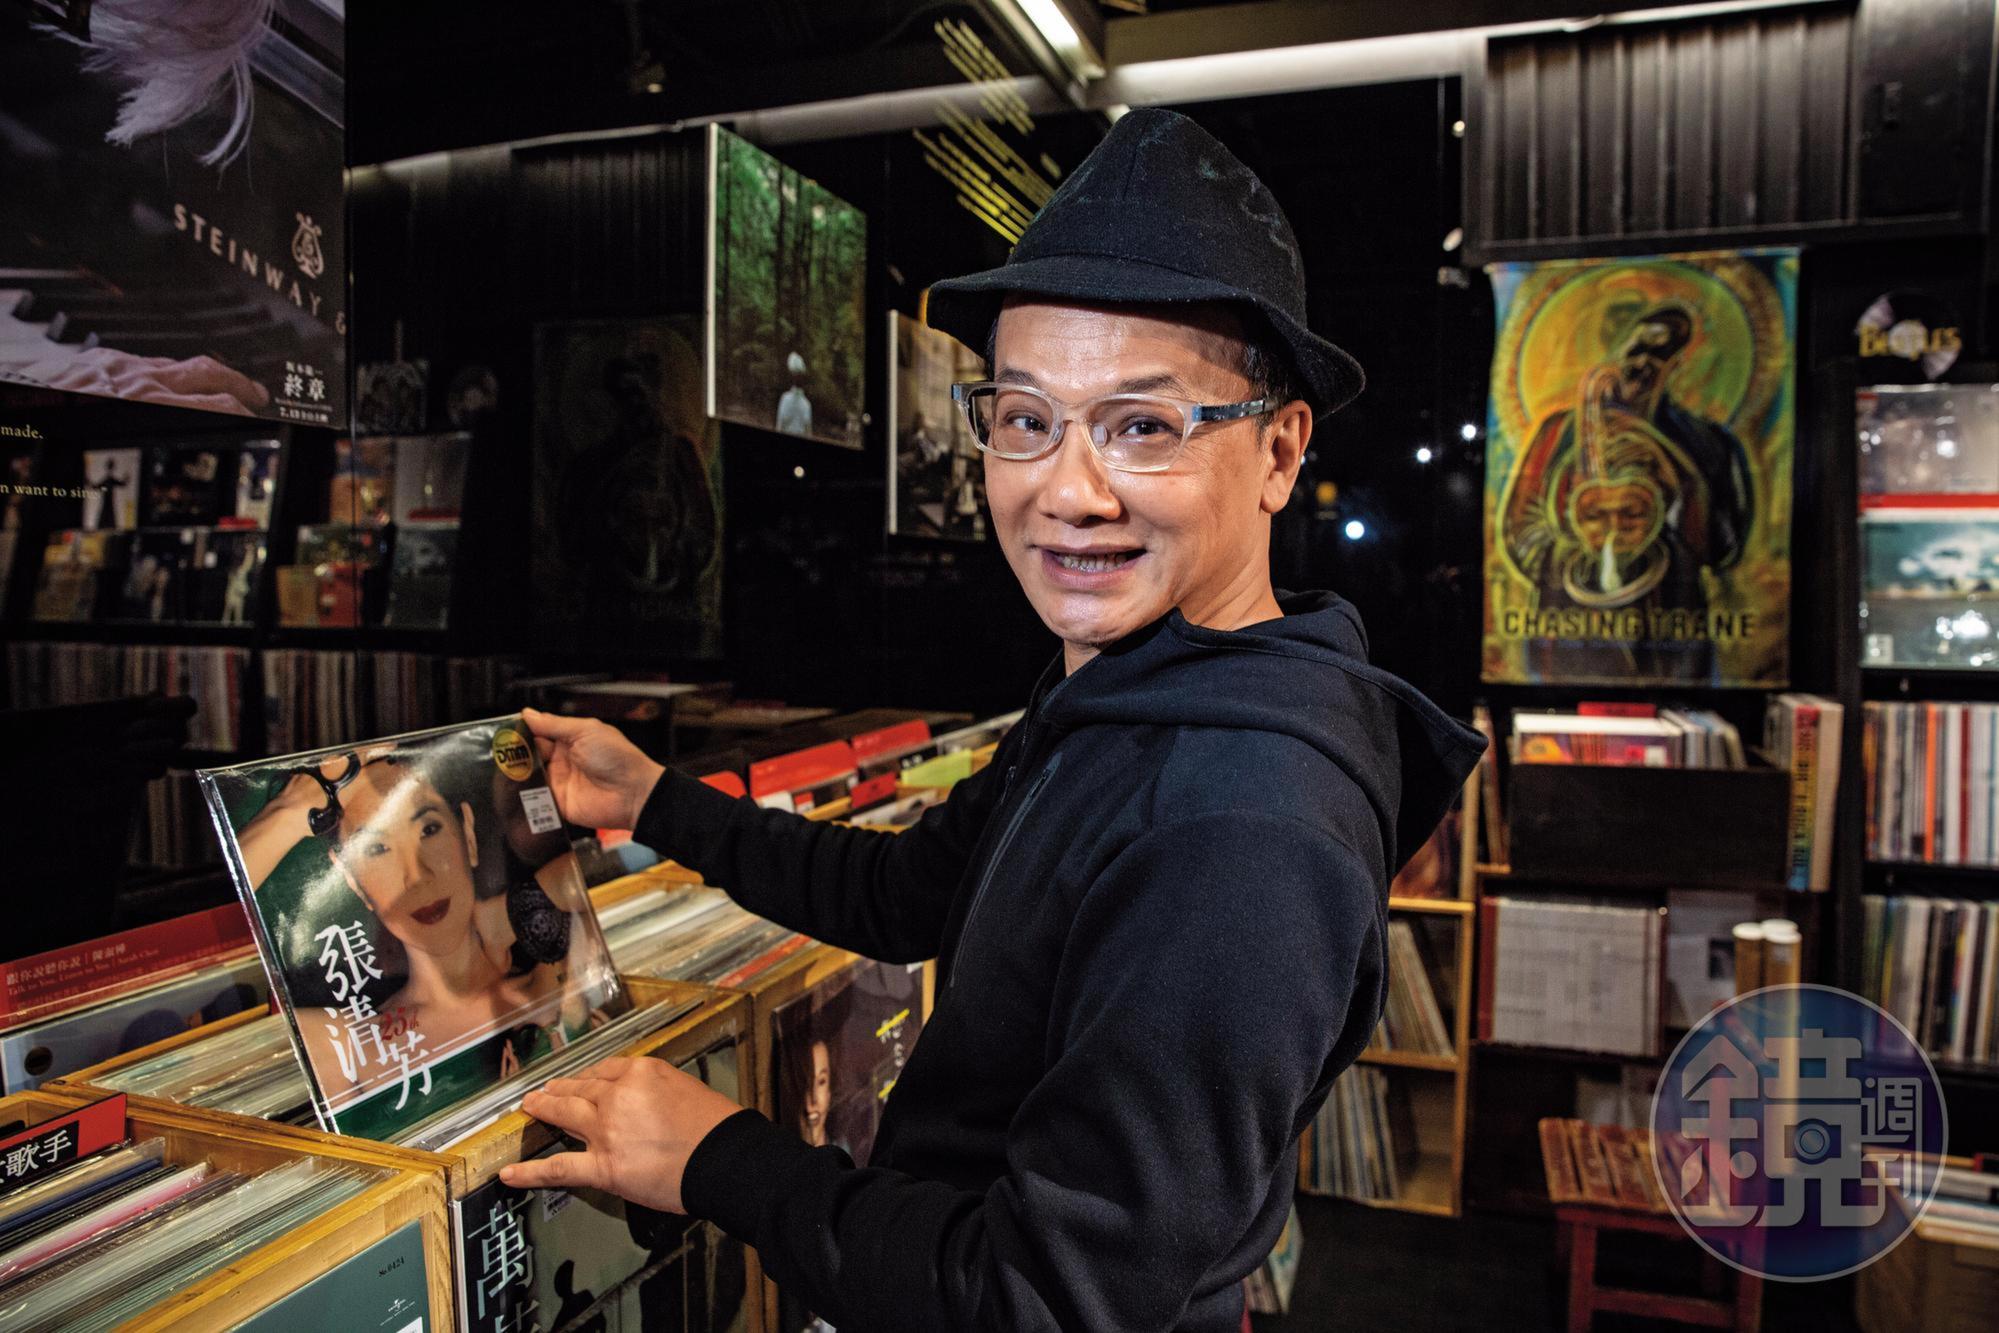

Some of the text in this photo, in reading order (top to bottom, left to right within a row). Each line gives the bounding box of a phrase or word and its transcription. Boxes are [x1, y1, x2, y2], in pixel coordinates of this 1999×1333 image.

[174, 203, 322, 316] STEINWAY
[284, 373, 325, 401] 終章
[14, 484, 48, 496] want
[53, 487, 67, 498] to
[1502, 609, 1757, 638] CHASING TRANE
[314, 920, 432, 1111] 張清芳
[0, 1130, 72, 1184] 歌手
